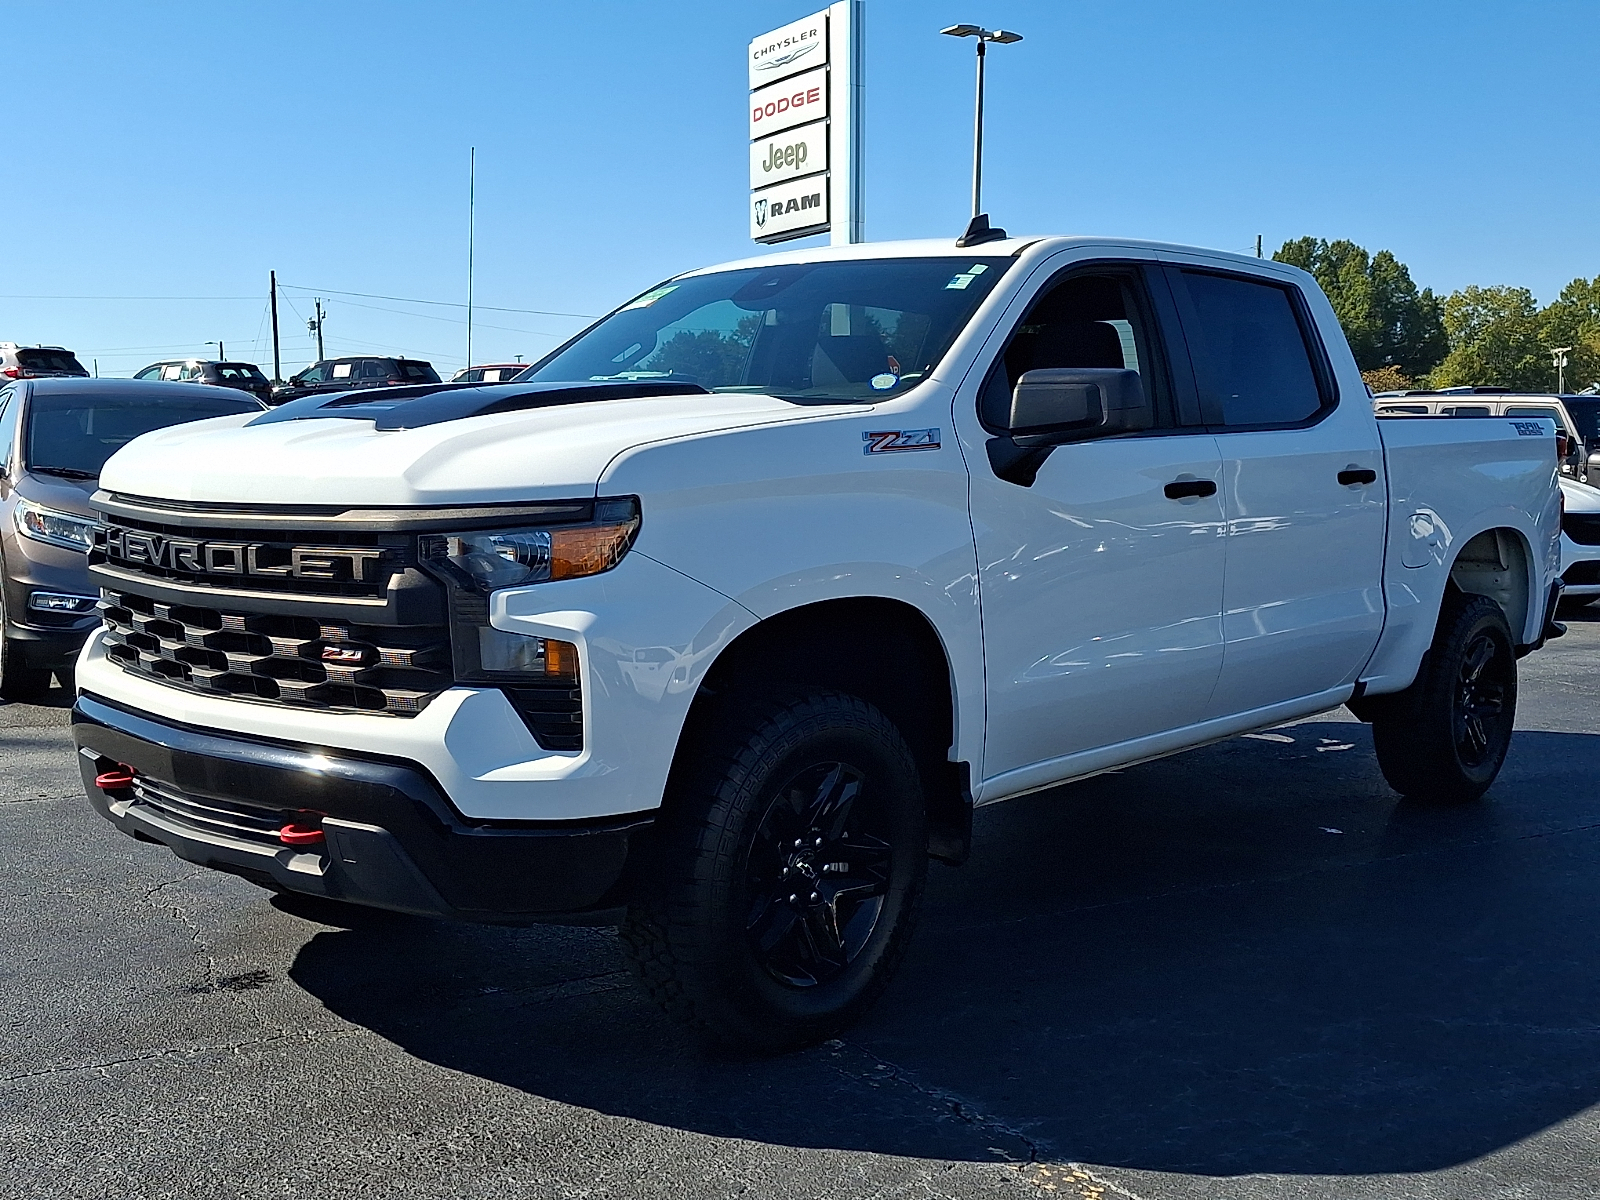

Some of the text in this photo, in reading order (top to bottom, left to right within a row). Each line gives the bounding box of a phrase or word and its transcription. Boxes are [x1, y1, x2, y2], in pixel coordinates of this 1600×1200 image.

[753, 28, 818, 60] CHRYSLER
[753, 87, 820, 122] DODGE
[762, 141, 808, 173] Jeep
[770, 193, 821, 217] RAM
[1509, 422, 1545, 430] TRAIL
[862, 427, 942, 456] Z71
